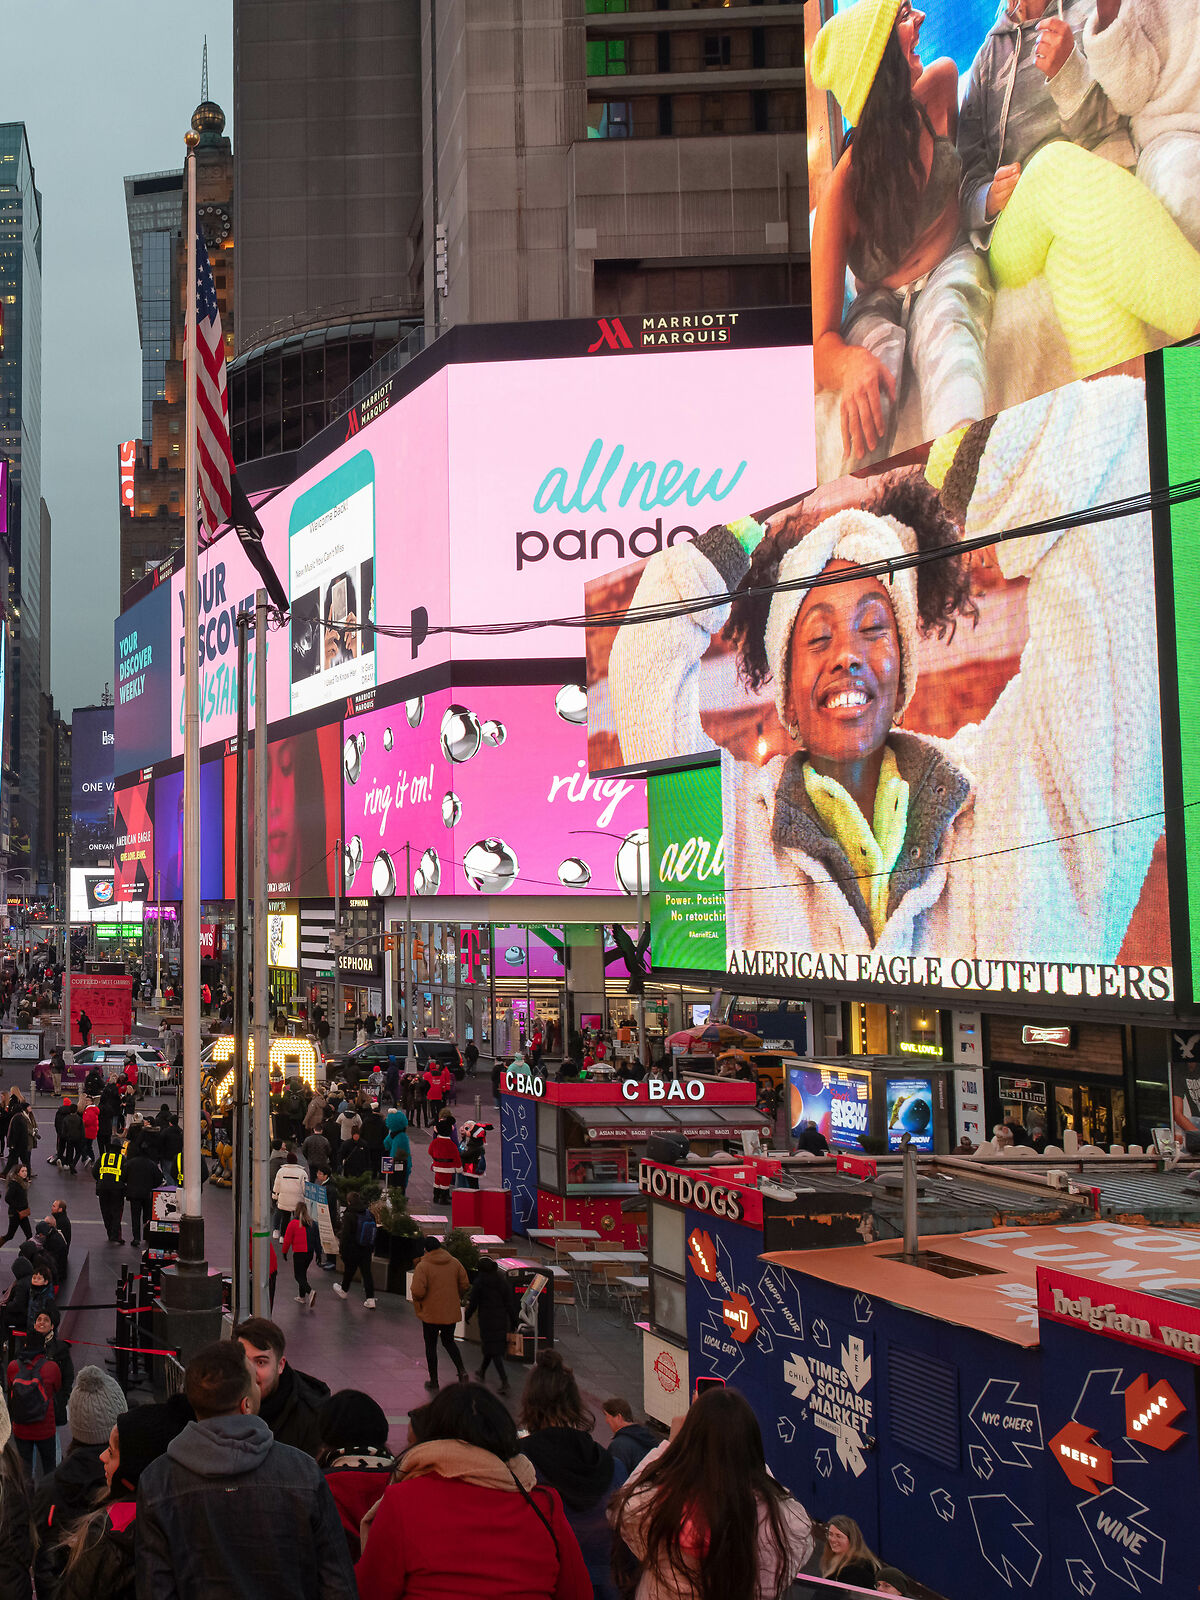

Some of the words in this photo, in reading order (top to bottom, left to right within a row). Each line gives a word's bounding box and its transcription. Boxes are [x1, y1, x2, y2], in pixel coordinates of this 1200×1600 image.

[643, 313, 739, 330] MARRIOTT
[643, 329, 728, 346] MARQUIS
[361, 379, 394, 413] MARRIOTT
[361, 398, 390, 426] MARQUIS
[533, 438, 625, 514] all
[618, 459, 748, 512] new
[119, 630, 138, 659] YOUR
[119, 645, 153, 682] DISCOVER
[119, 673, 146, 705] WEEKLY
[355, 690, 377, 704] MARRIOTT
[355, 700, 375, 712] MARQUIS
[82, 782, 103, 793] ONE
[363, 776, 393, 837] ring
[395, 769, 410, 810] it
[410, 763, 436, 803] on!
[547, 759, 635, 828] ring
[116, 832, 137, 847] AMERICAN
[137, 830, 151, 843] EAGLE
[349, 899, 369, 907] SEPHORA
[665, 894, 694, 906] Power.
[671, 910, 683, 921] No
[338, 955, 374, 972] SEPHORA
[728, 950, 849, 982] AMERICAN
[855, 953, 943, 988] EAGLE
[950, 957, 1172, 1000] OUTFITTERS
[11, 1041, 39, 1052] FROZEN
[505, 1073, 515, 1091] C
[516, 1074, 543, 1098] BAO
[622, 1079, 640, 1101] C
[648, 1079, 706, 1101] BAO
[966, 1082, 978, 1095] NBA
[830, 1098, 867, 1118] SNOW
[830, 1112, 868, 1132] SHOW
[638, 1161, 746, 1221] HOTDOGS
[691, 1236, 710, 1274] LOCAL
[715, 1270, 732, 1294] BEER
[764, 1277, 785, 1305] HAPPY
[781, 1306, 801, 1334] HOUR
[1050, 1288, 1153, 1340] belgian
[703, 1334, 721, 1351] LOCAL
[721, 1342, 738, 1358] EATS
[788, 1370, 810, 1385] CHILL
[807, 1355, 850, 1389] TIMES
[817, 1378, 873, 1419] SQUARE
[809, 1393, 869, 1435] MARKET
[981, 1411, 1001, 1427] NYC
[1002, 1415, 1034, 1434] CHEFS
[1132, 1395, 1169, 1432] DRINK
[844, 1437, 859, 1463] EAT
[1060, 1443, 1099, 1469] MEET
[1095, 1510, 1148, 1556] WINE
